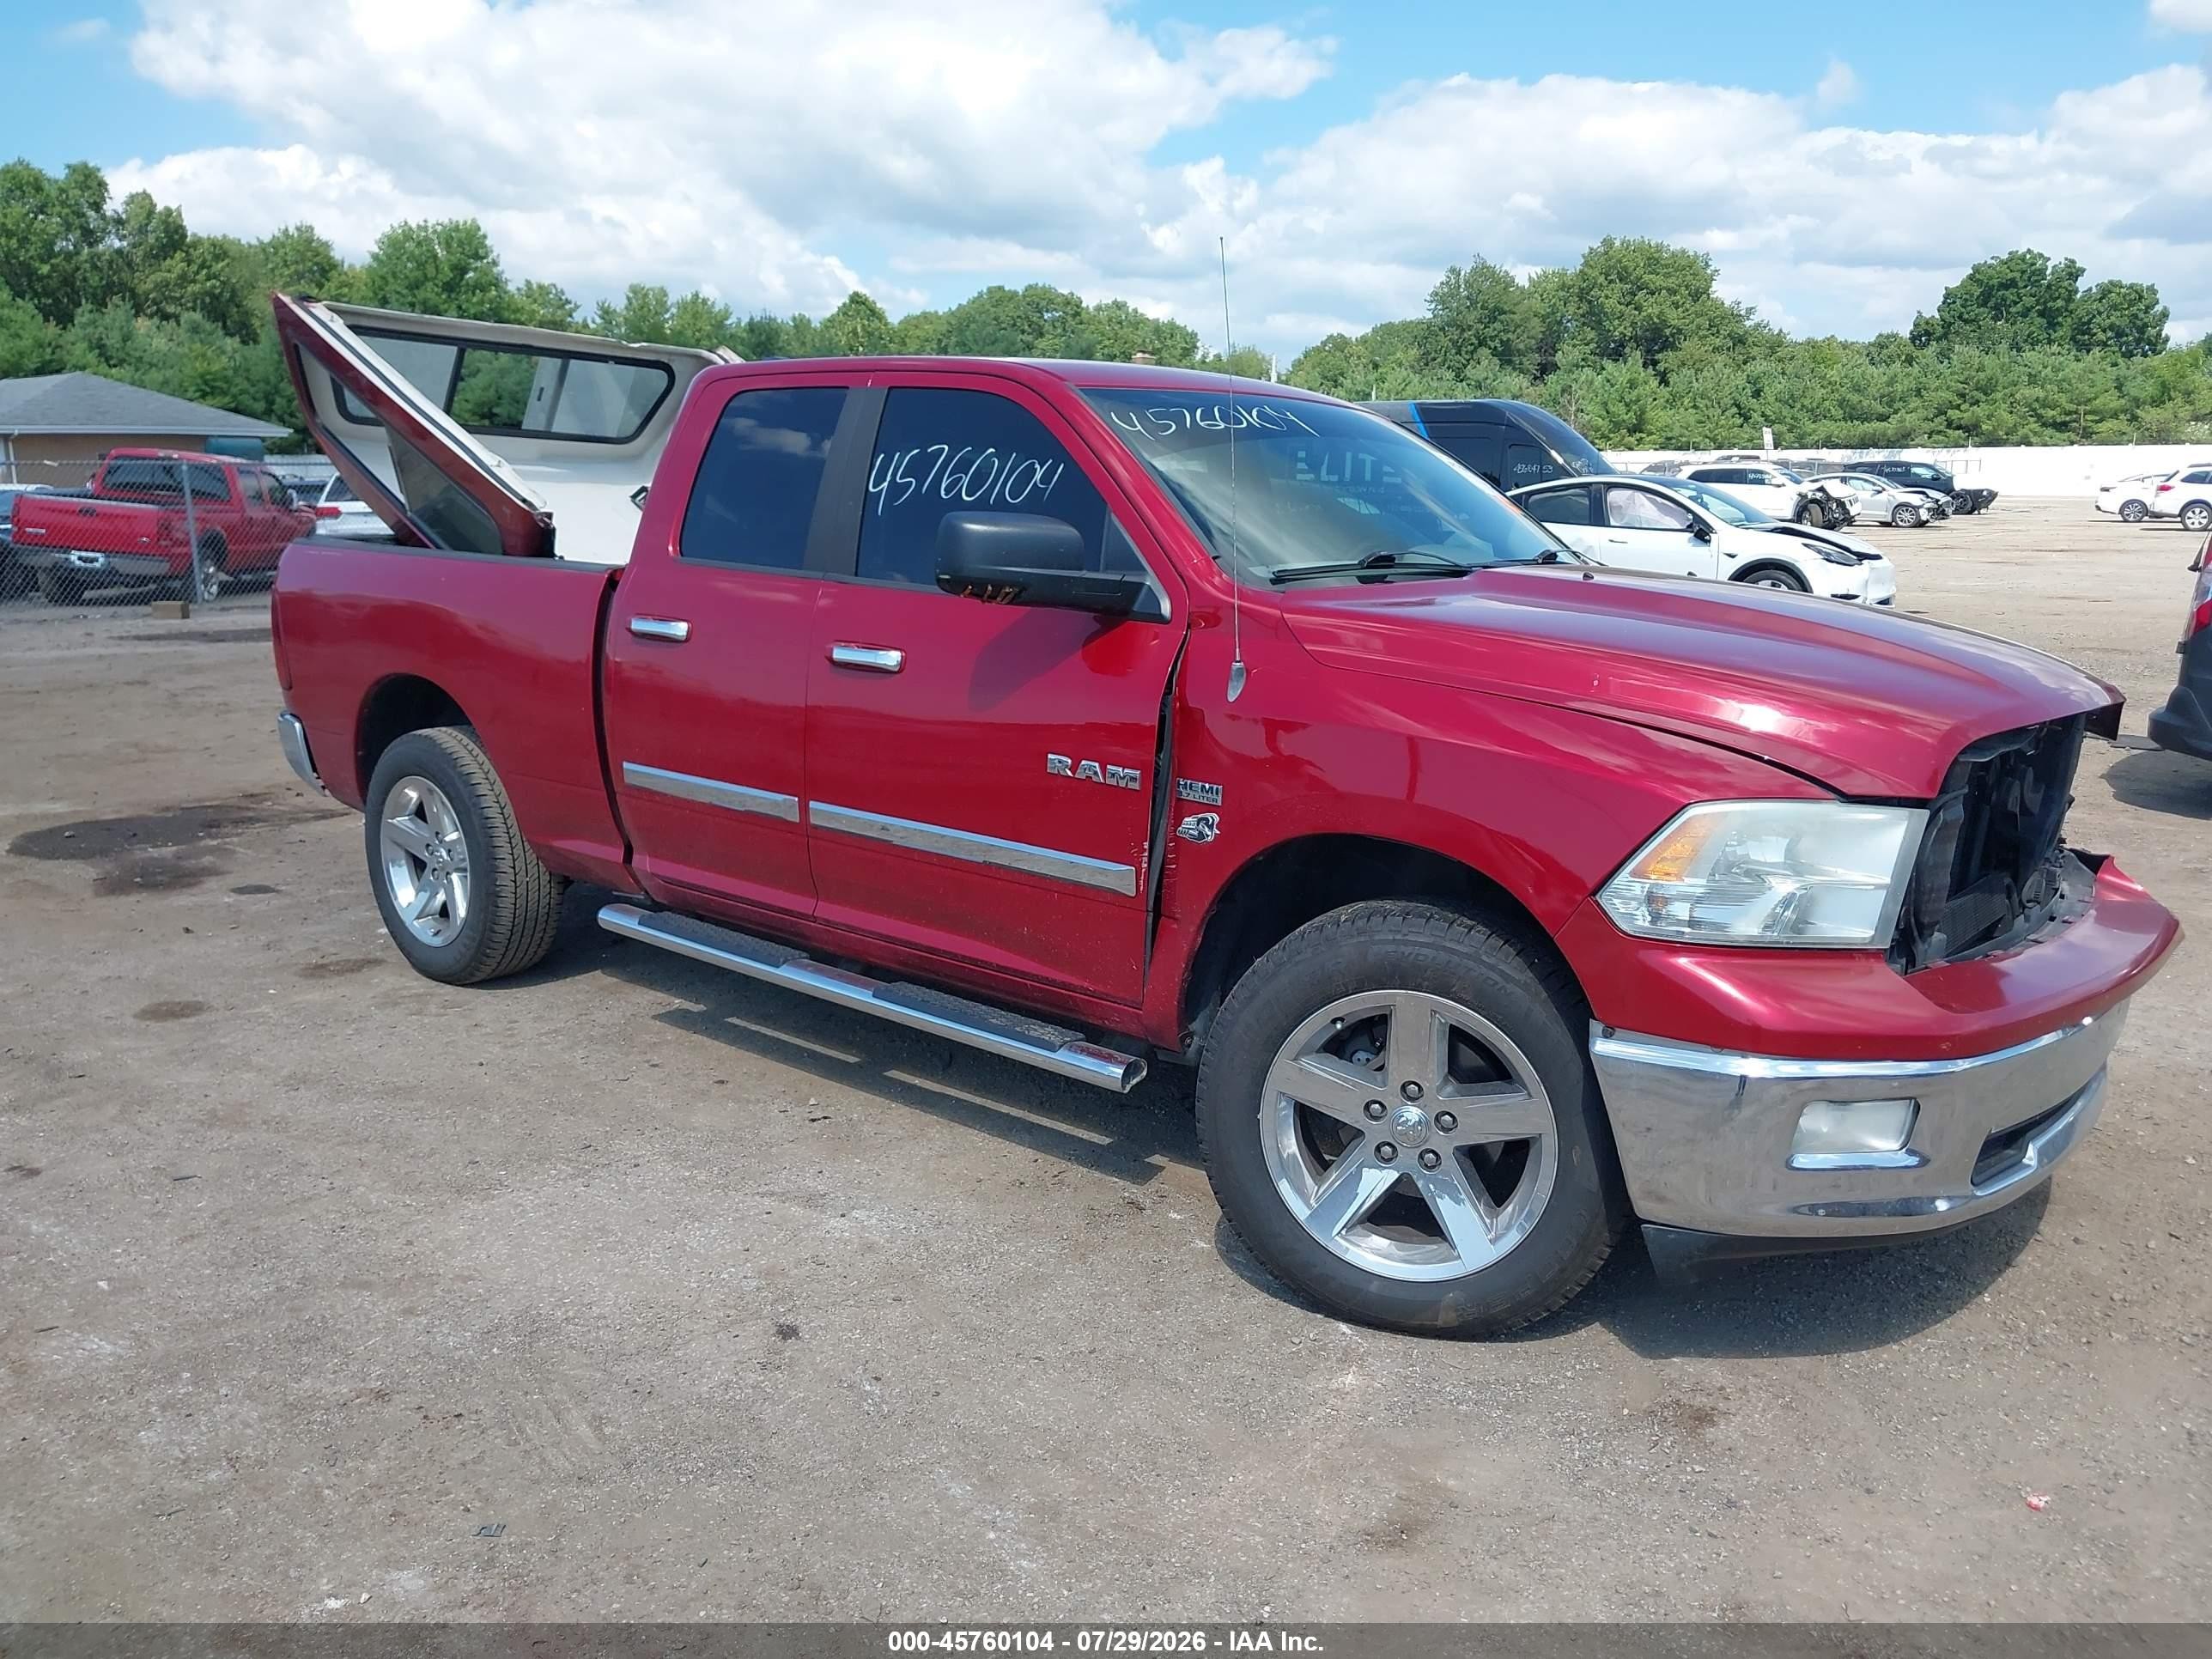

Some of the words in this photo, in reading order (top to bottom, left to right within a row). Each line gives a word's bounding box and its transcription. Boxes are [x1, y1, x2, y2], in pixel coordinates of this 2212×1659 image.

[1110, 404, 1321, 441] 45760104
[868, 444, 1065, 516] 45760104
[1046, 752, 1142, 791] RAM
[1176, 777, 1220, 796] HEMI
